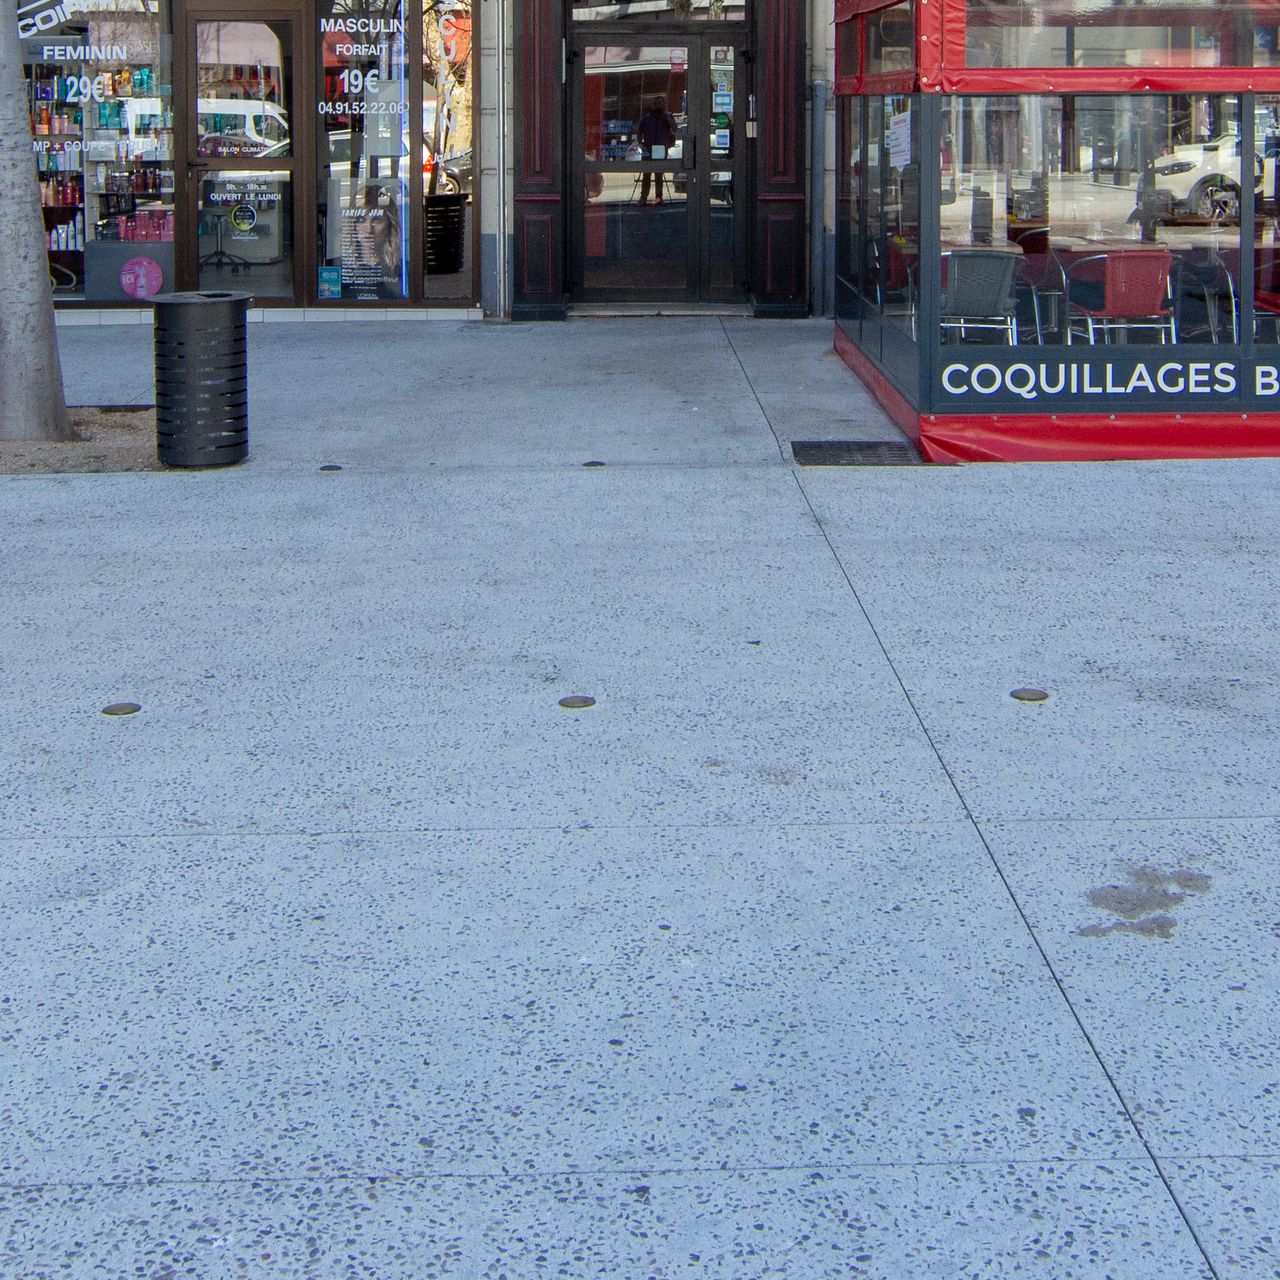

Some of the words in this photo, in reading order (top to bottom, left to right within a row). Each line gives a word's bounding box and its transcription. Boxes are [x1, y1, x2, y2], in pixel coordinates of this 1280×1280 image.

[320, 18, 404, 33] MASCULIN
[43, 46, 128, 60] FEMININ
[336, 44, 389, 56] FORFAIT
[66, 76, 106, 103] 29€
[32, 141, 50, 152] MP
[54, 143, 61, 151] +
[64, 141, 108, 152] COUPE
[341, 209, 365, 217] TARIFS
[942, 362, 1237, 399] COQUILLAGES
